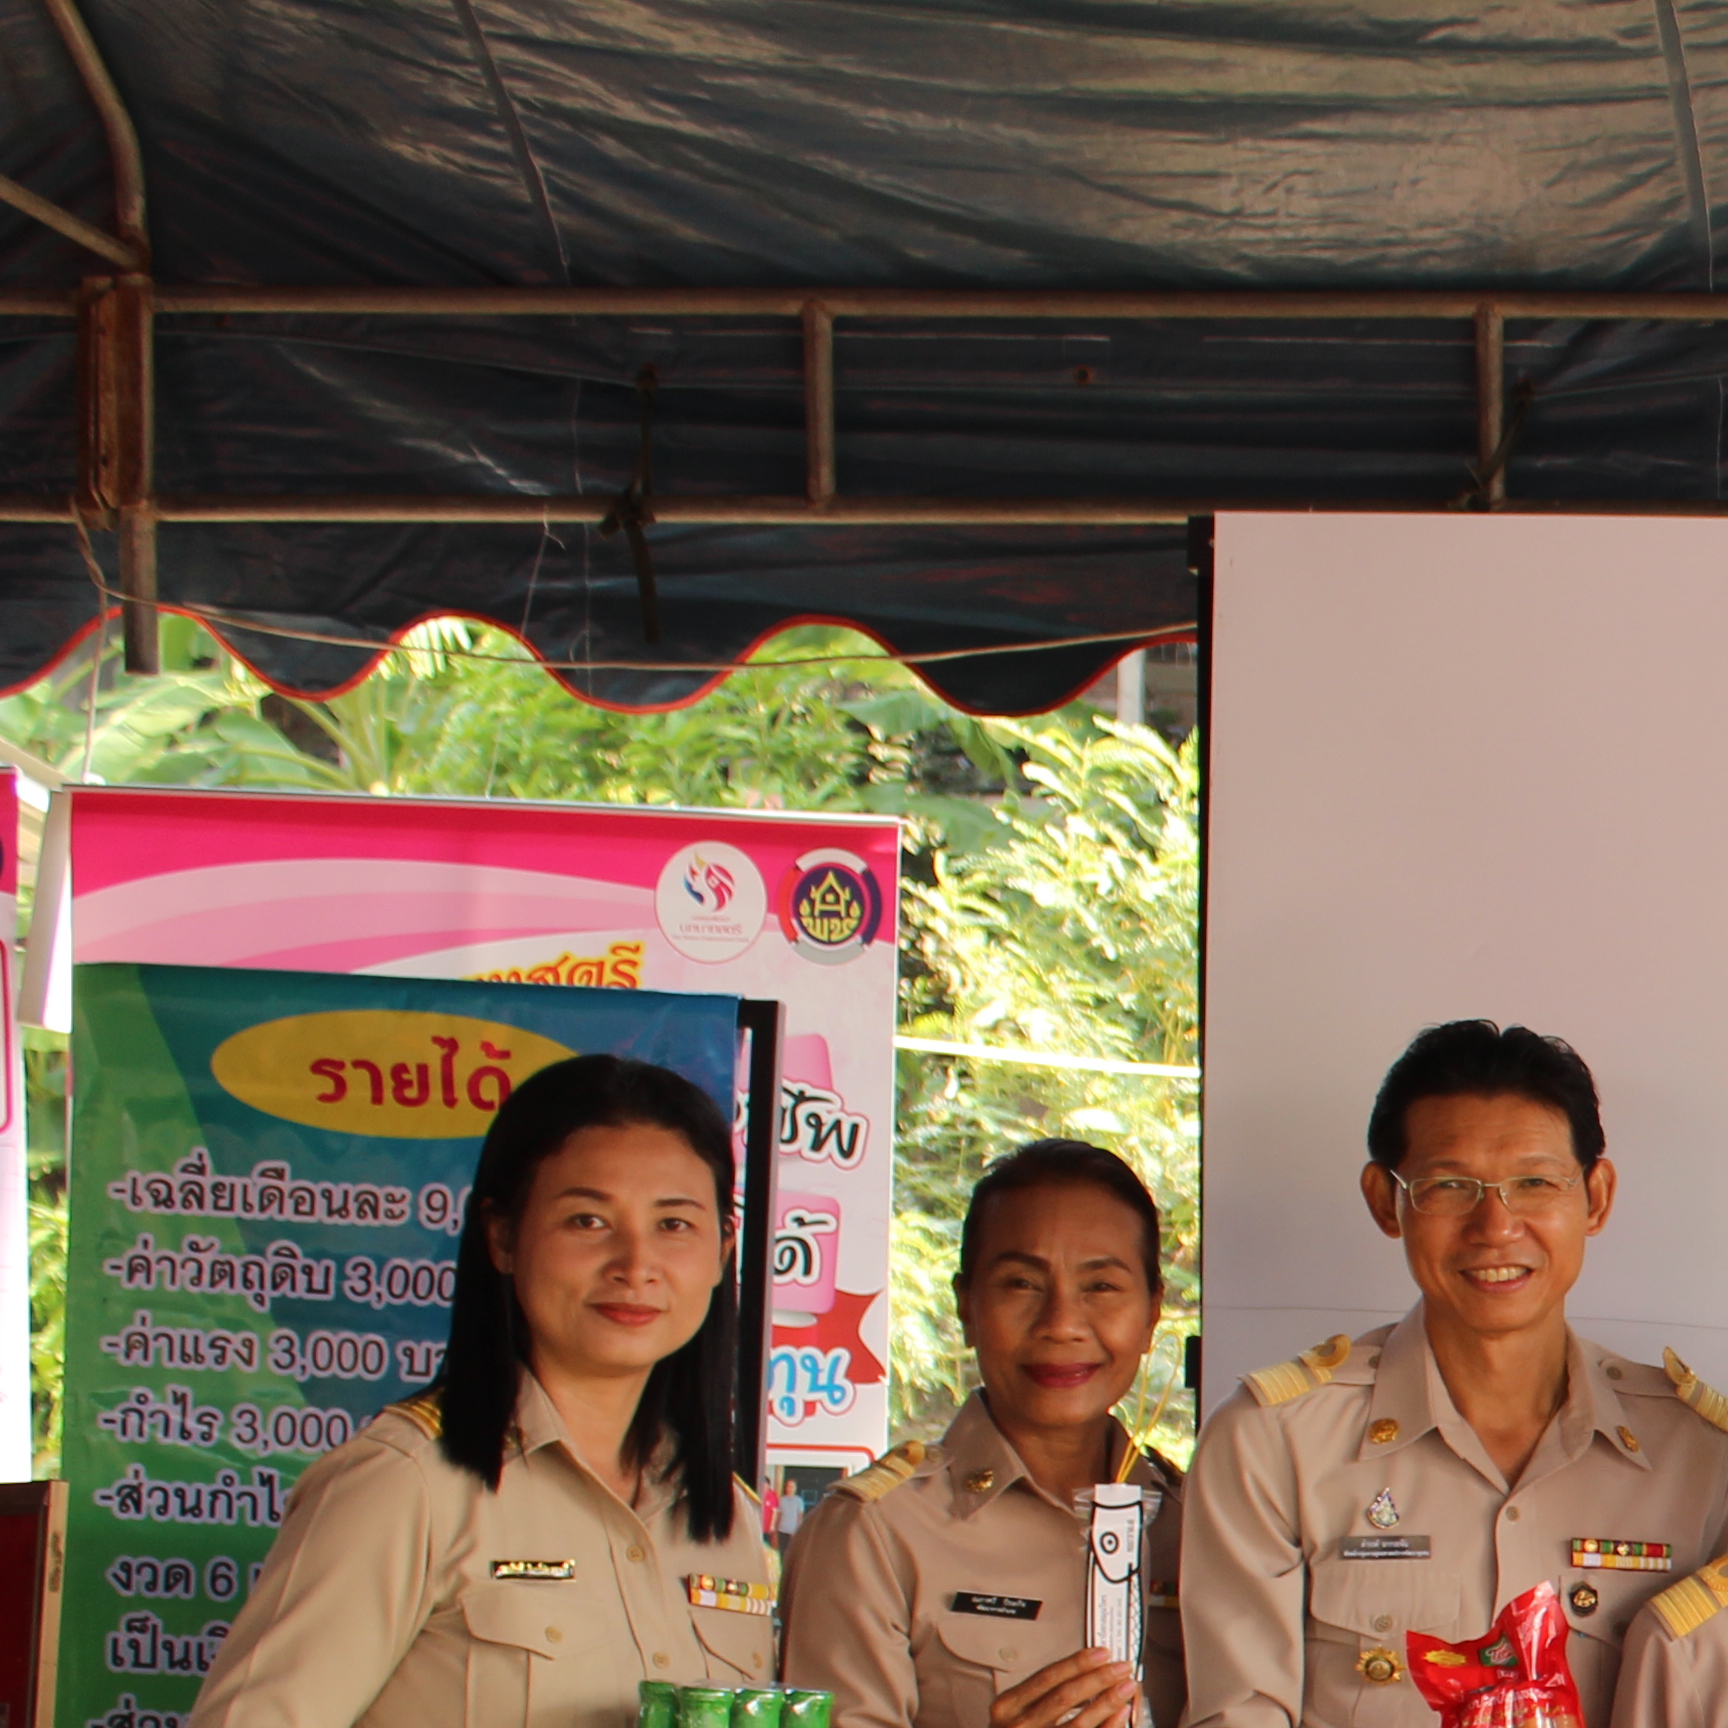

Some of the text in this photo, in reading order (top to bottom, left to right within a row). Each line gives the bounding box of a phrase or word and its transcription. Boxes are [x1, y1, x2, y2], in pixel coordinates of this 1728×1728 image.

[309, 1035, 513, 1112] รายได้
[272, 1332, 386, 1378] 3,000
[110, 1559, 192, 1596] งวด
[209, 1560, 235, 1598] 6
